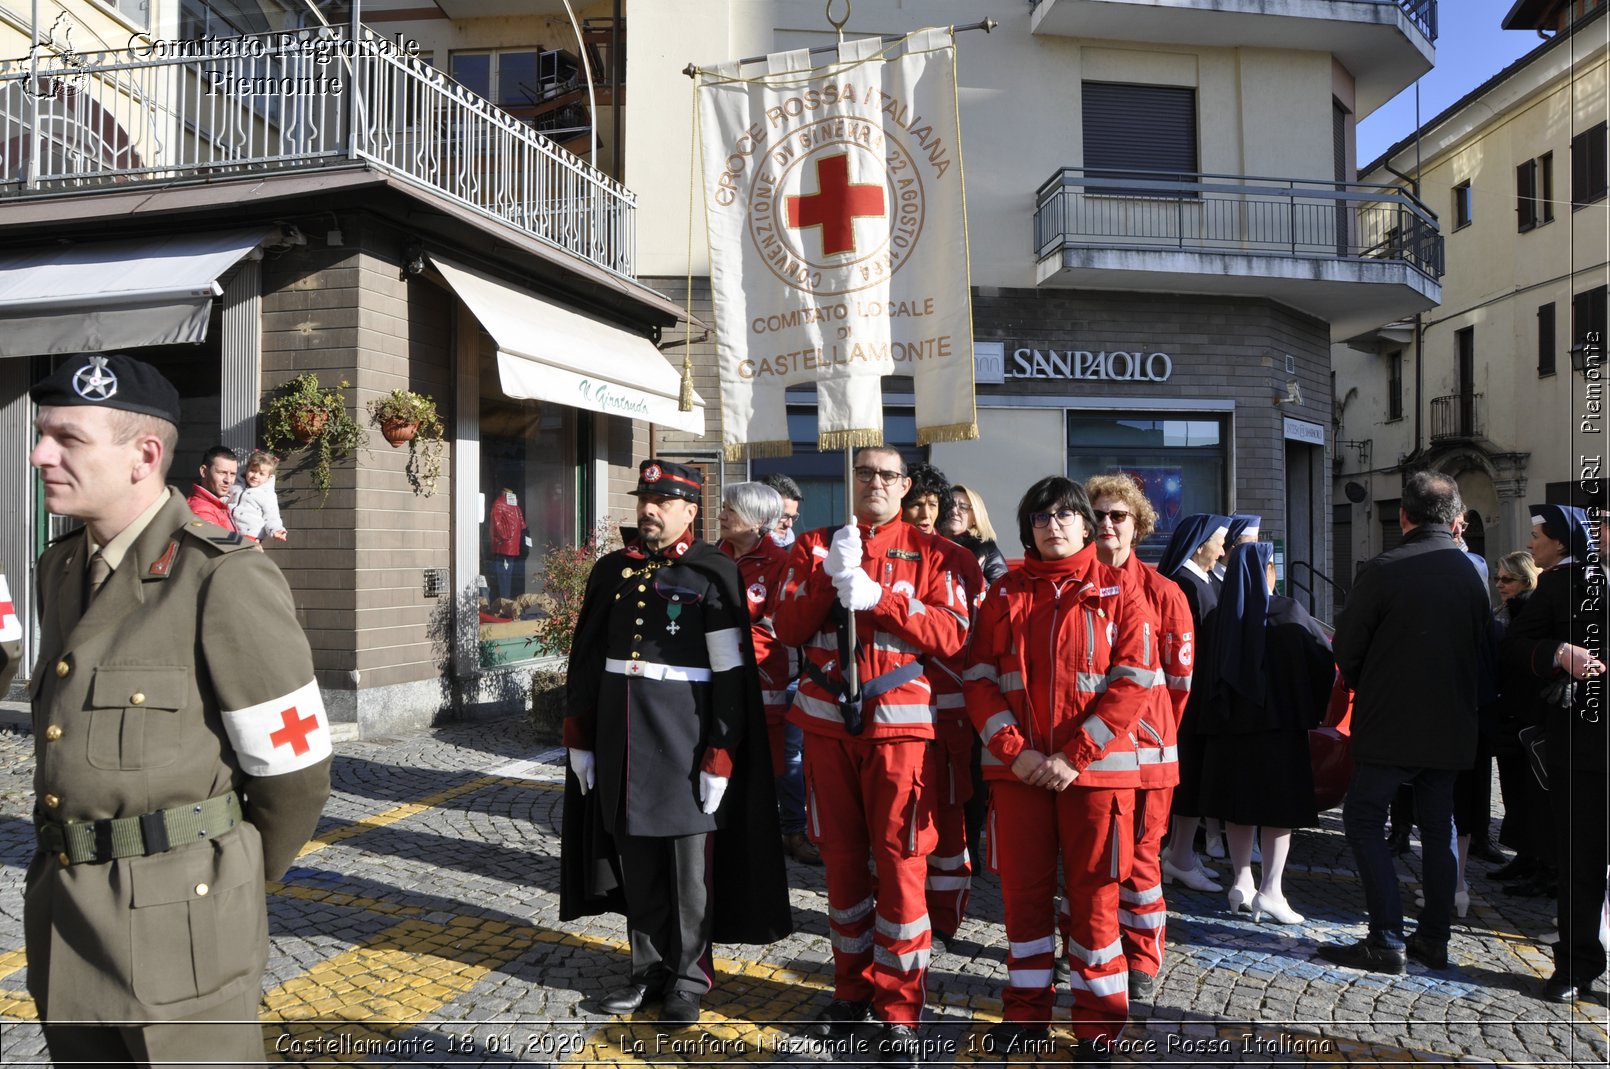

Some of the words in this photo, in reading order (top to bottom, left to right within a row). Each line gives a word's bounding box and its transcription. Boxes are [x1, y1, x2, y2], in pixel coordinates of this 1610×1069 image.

[715, 123, 767, 207] CROCE
[766, 83, 856, 128] ROSSA
[864, 86, 950, 180] ITALIANA
[800, 118, 883, 149] GINEVRA
[772, 144, 795, 167] DI
[886, 150, 908, 176] 22
[754, 171, 822, 288] CONVENZIONE
[897, 177, 918, 248] AGOSTO
[752, 304, 848, 334] COMITATO
[857, 298, 934, 318] LOCALE
[837, 327, 853, 340] DI
[738, 336, 952, 379] CASTELLAMONTE
[1012, 348, 1173, 382] SANPAOLO
